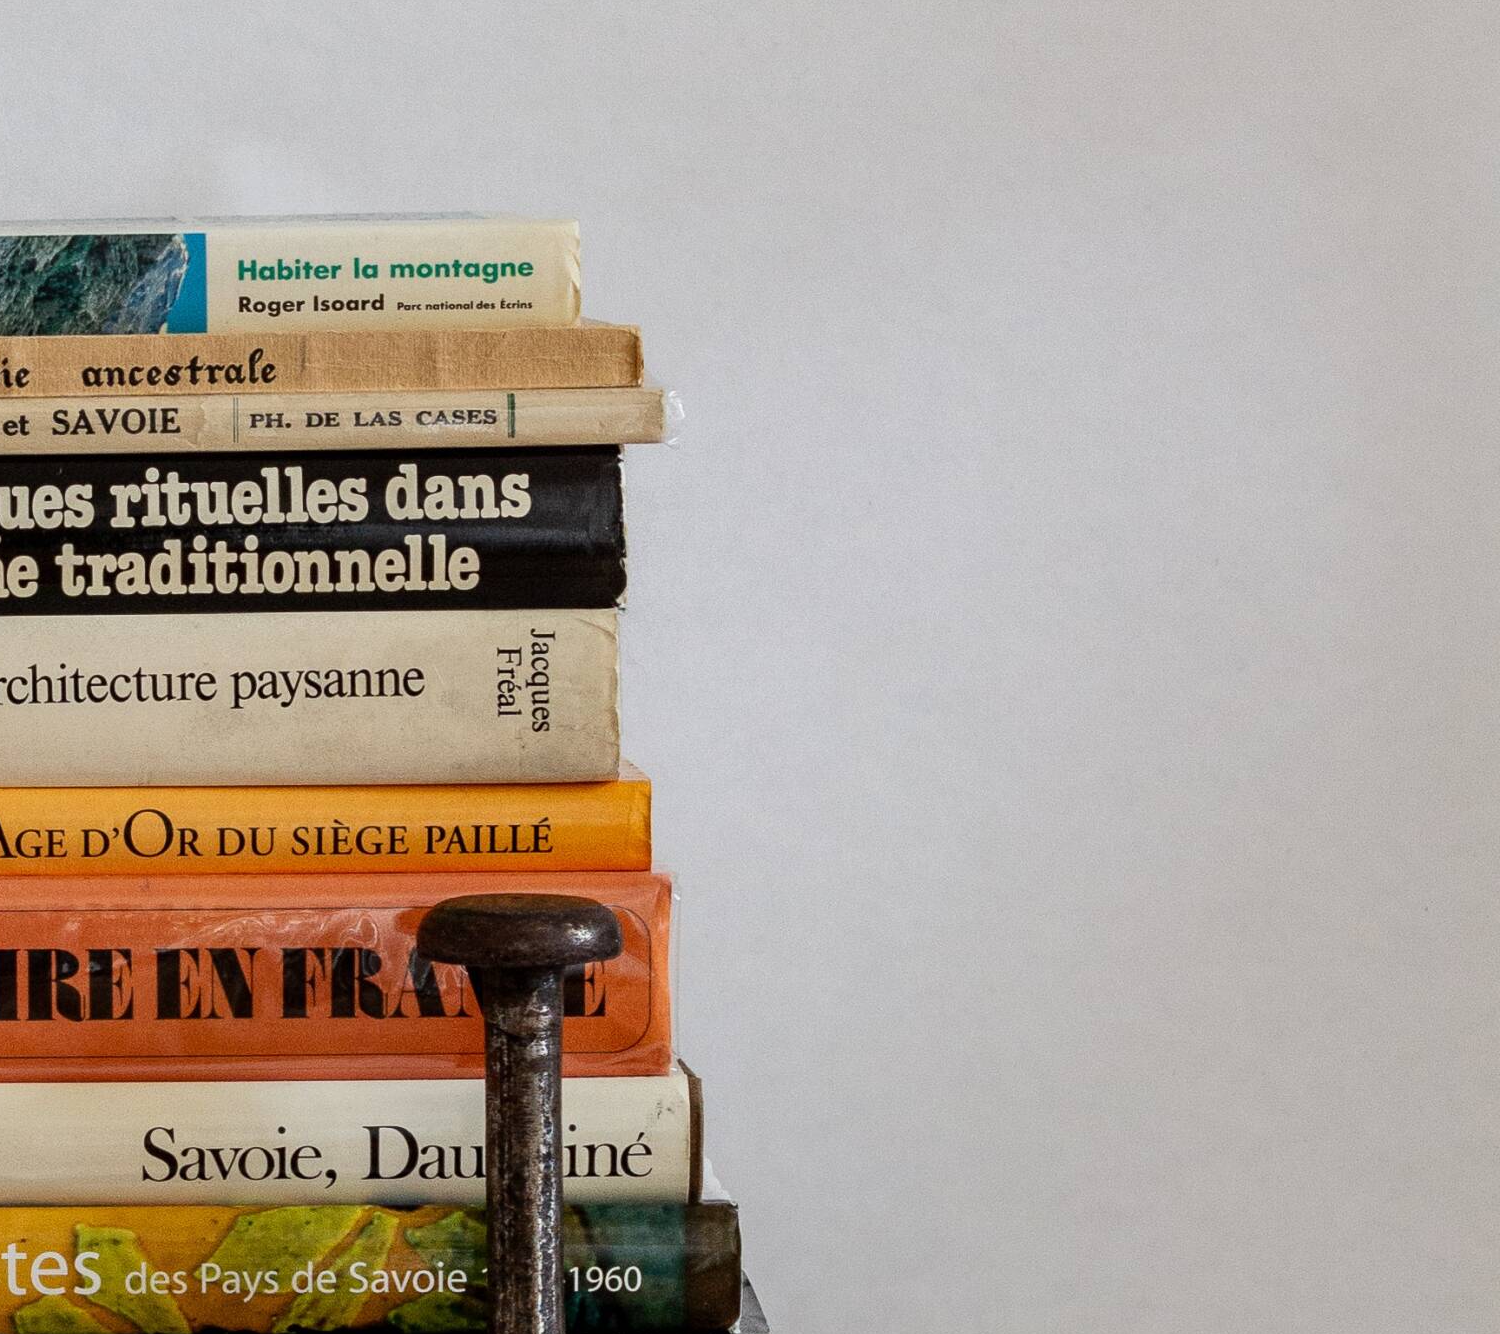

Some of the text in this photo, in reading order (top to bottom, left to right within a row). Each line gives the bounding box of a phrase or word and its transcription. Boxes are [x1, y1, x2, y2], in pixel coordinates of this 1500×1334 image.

[238, 257, 534, 284] Habiter la montagne
[238, 293, 533, 318] Roger Isoard Parc national des Écrins
[81, 347, 277, 388] ancestrale
[2, 415, 30, 437] et
[51, 407, 182, 436] SAVOIE
[249, 409, 498, 429] PH. DE LAS CASES
[109, 465, 369, 528] rituelles
[385, 463, 532, 521] dans
[54, 533, 480, 597] traditionnelle
[230, 667, 426, 710] paysanne
[496, 646, 523, 718] Fréal
[525, 628, 556, 733] Jacques
[215, 827, 277, 857] DU
[291, 818, 410, 857] SIÈGE
[424, 816, 554, 855] PAILLÉ
[155, 947, 262, 1021] EN
[281, 946, 606, 1019] FRAE
[142, 1124, 653, 1189] Savoie, Dauiné
[124, 1261, 188, 1295] des
[199, 1262, 279, 1302] Pays
[291, 1261, 338, 1294] de
[349, 1261, 468, 1295] Savoie
